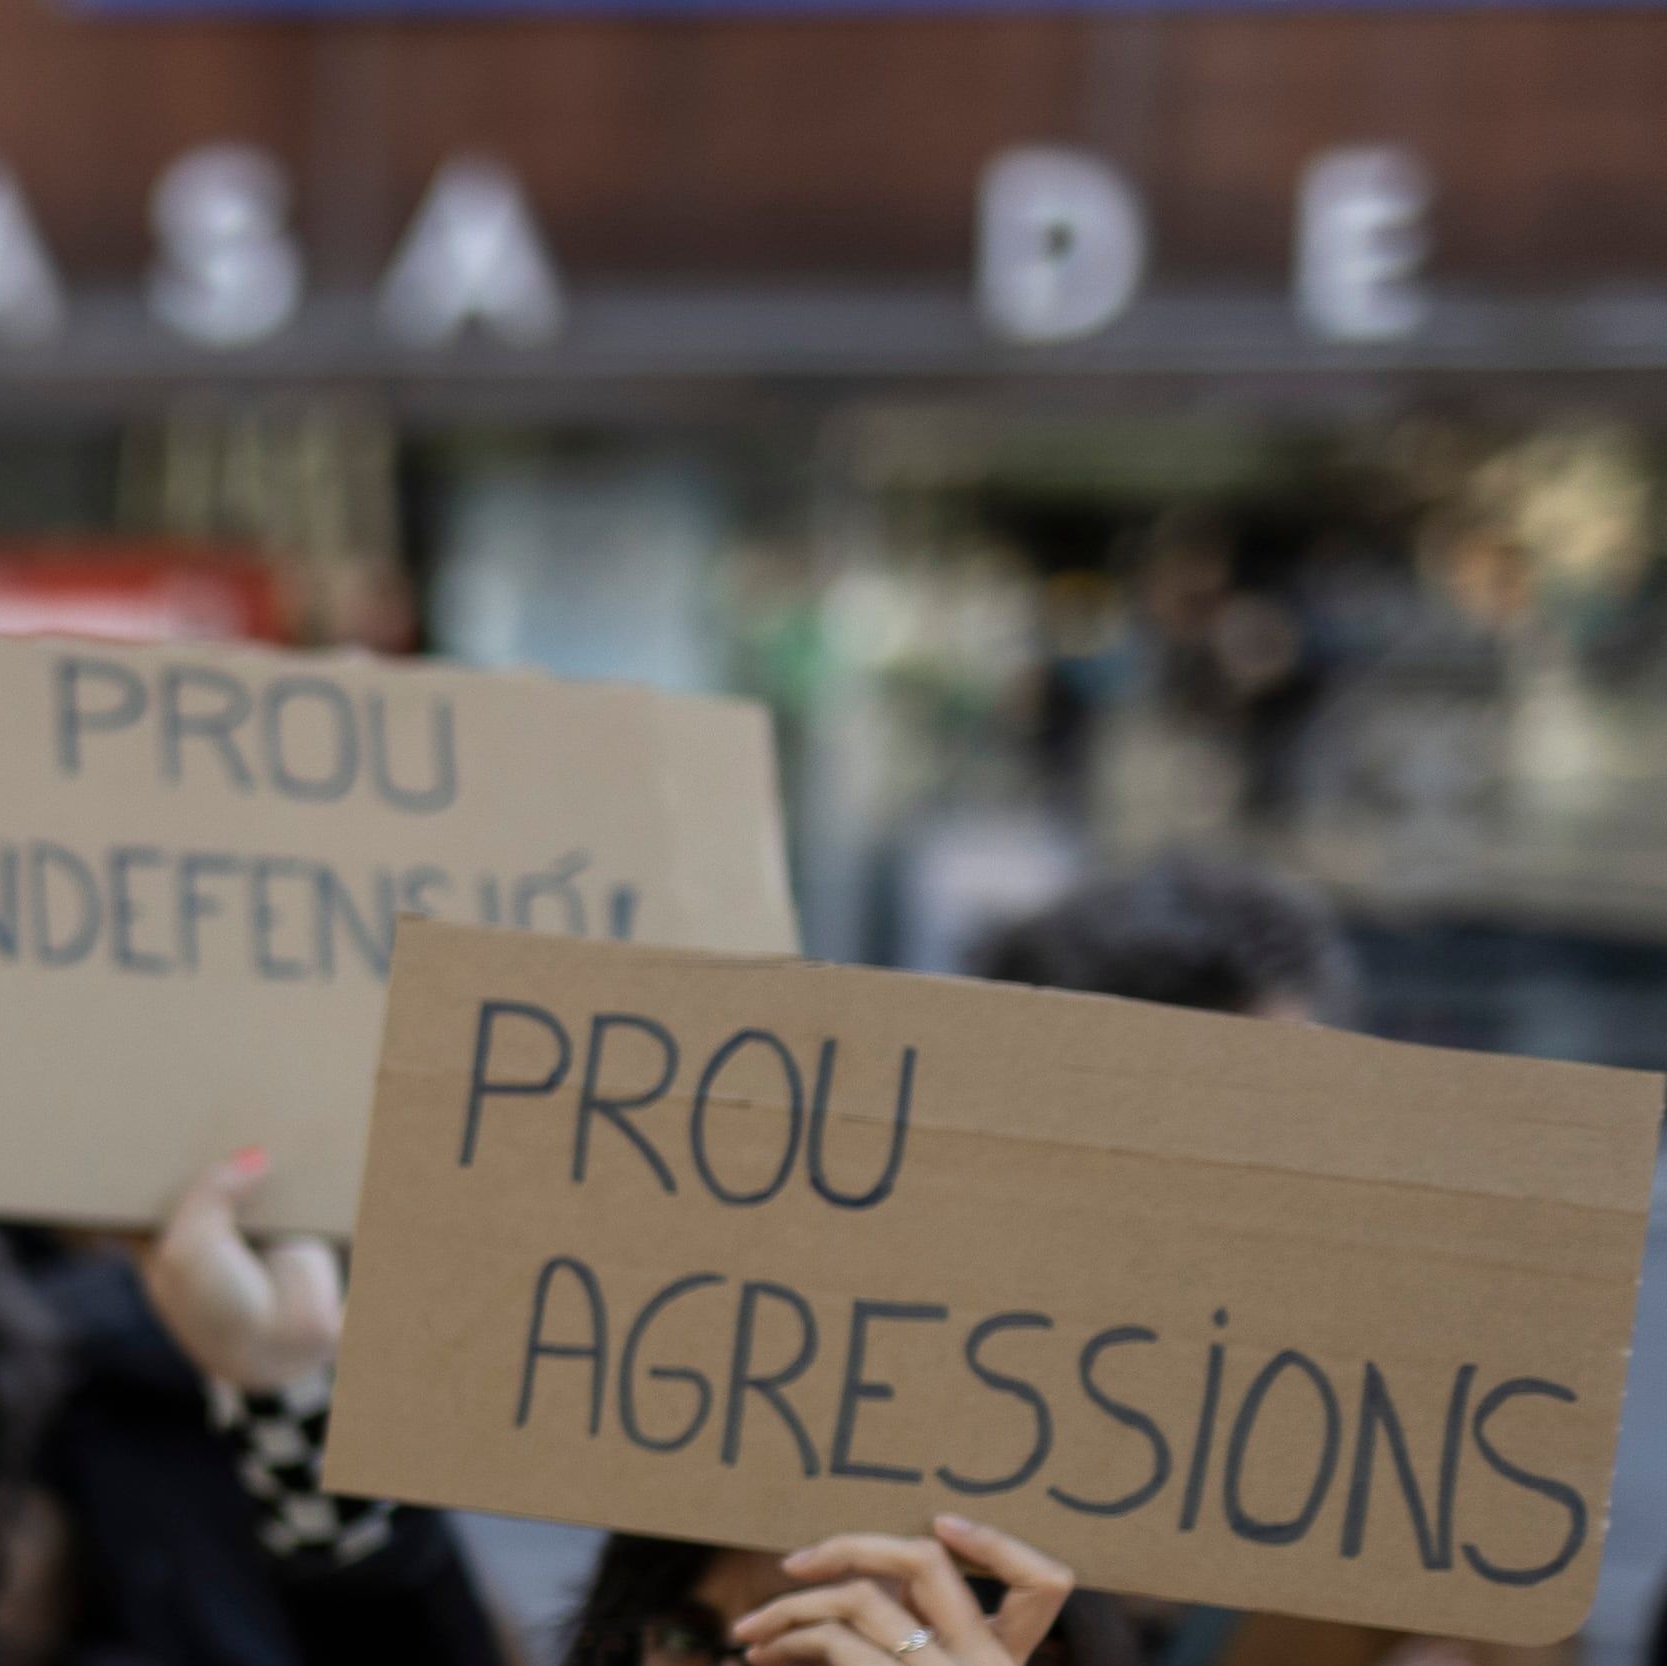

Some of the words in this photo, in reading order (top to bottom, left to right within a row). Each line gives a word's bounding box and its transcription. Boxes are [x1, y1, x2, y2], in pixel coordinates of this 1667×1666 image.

[975, 143, 1435, 345] DE
[52, 655, 459, 814] PROU
[459, 1000, 919, 1209] PROU
